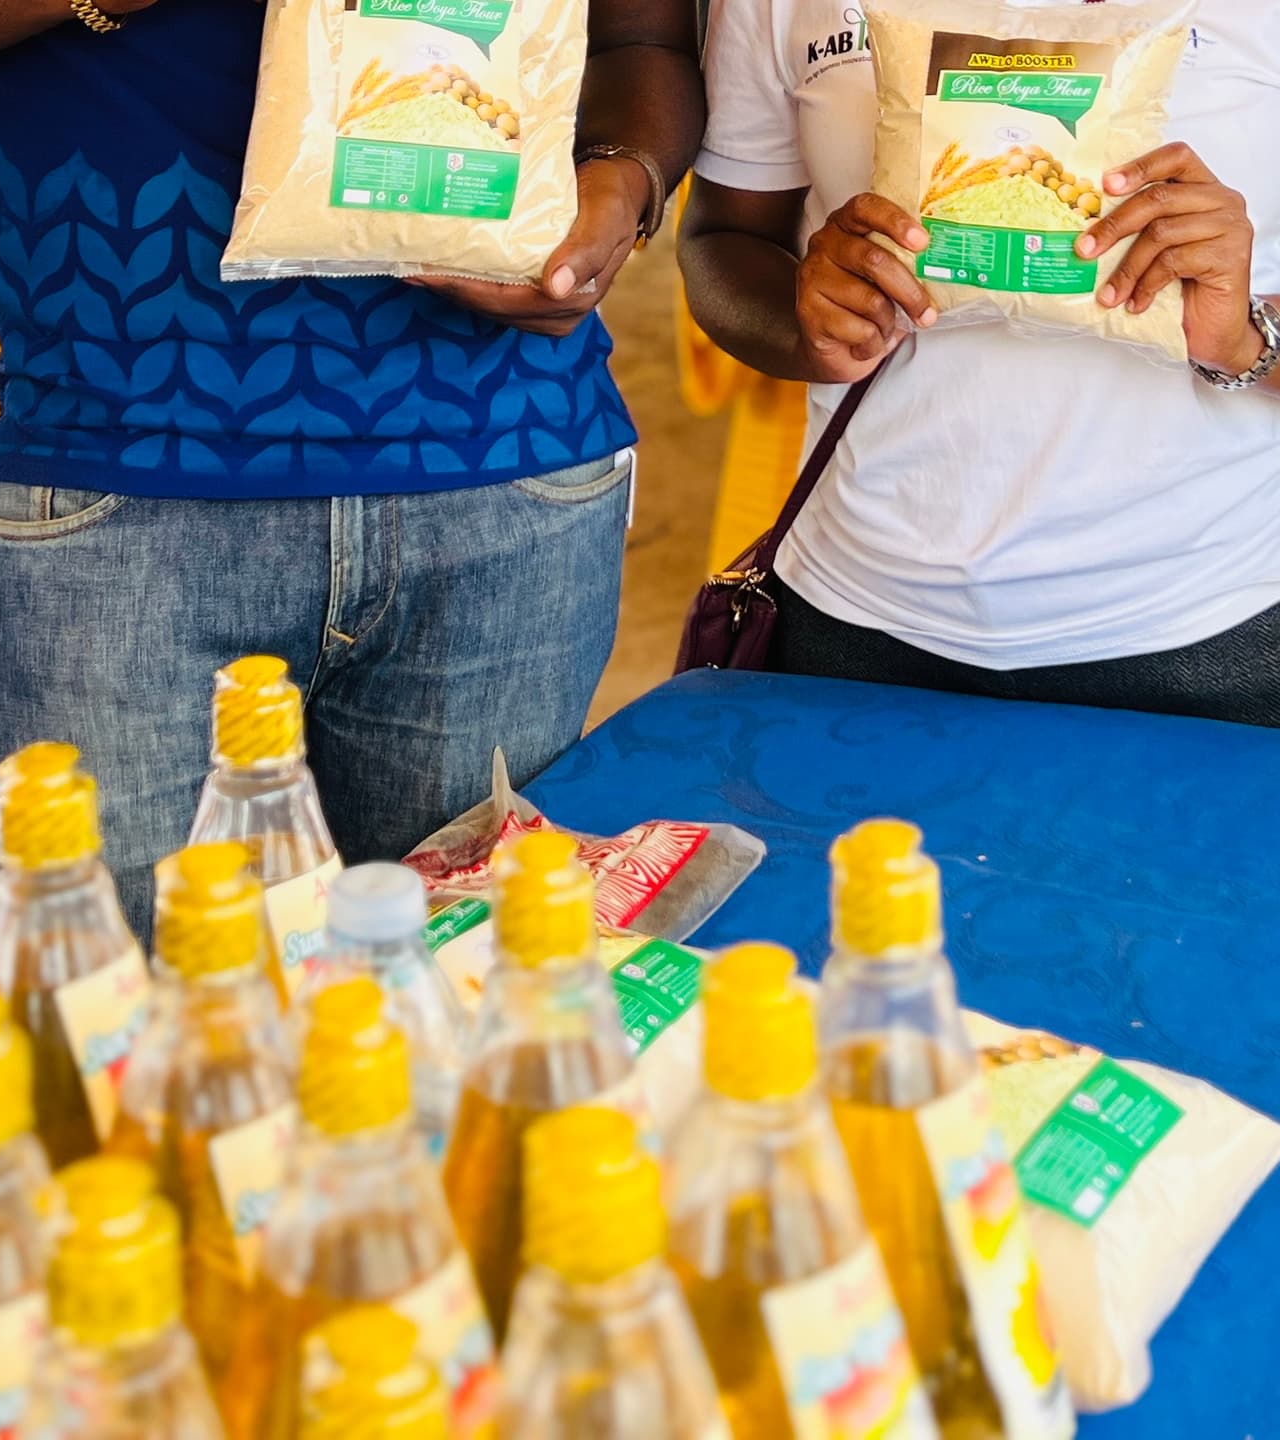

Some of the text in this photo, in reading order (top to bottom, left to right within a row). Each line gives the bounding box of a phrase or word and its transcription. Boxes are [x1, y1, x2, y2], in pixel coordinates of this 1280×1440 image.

[969, 53, 1074, 67] AWELO BOOSTER
[950, 75, 1092, 102] Rice Soya Flour
